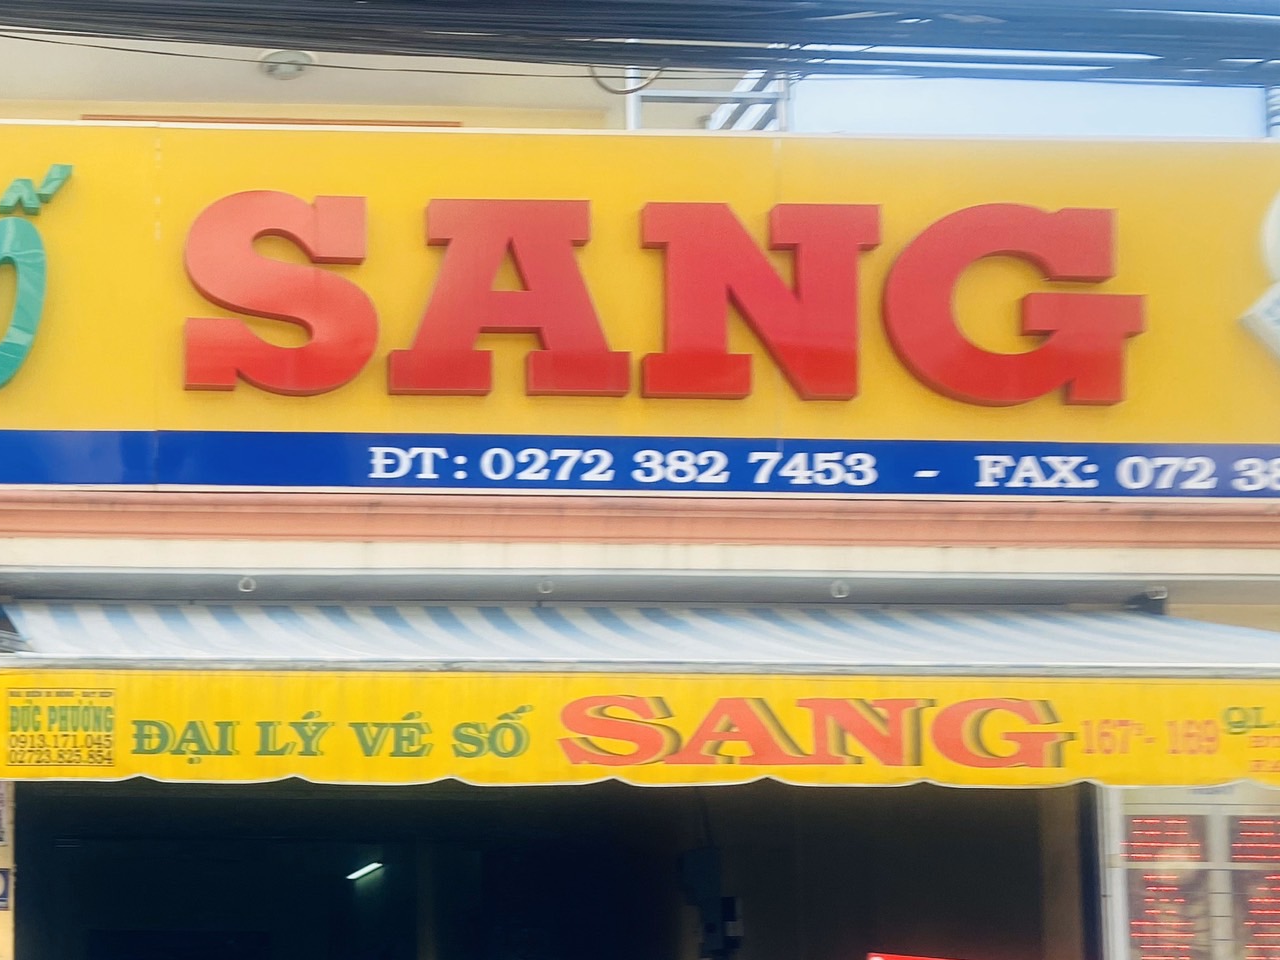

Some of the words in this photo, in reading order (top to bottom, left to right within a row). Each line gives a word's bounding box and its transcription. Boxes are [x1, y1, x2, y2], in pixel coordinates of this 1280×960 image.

[183, 190, 1148, 407] SANG
[480, 448, 616, 482] 0272
[632, 449, 730, 484] 382
[747, 452, 878, 487] 7453
[1116, 456, 1219, 490] 072
[131, 720, 239, 764] ĐẠI
[255, 711, 335, 758] LÝ
[349, 711, 434, 759] VÉ
[451, 705, 534, 759] SỐ
[558, 694, 1076, 769] SANG
